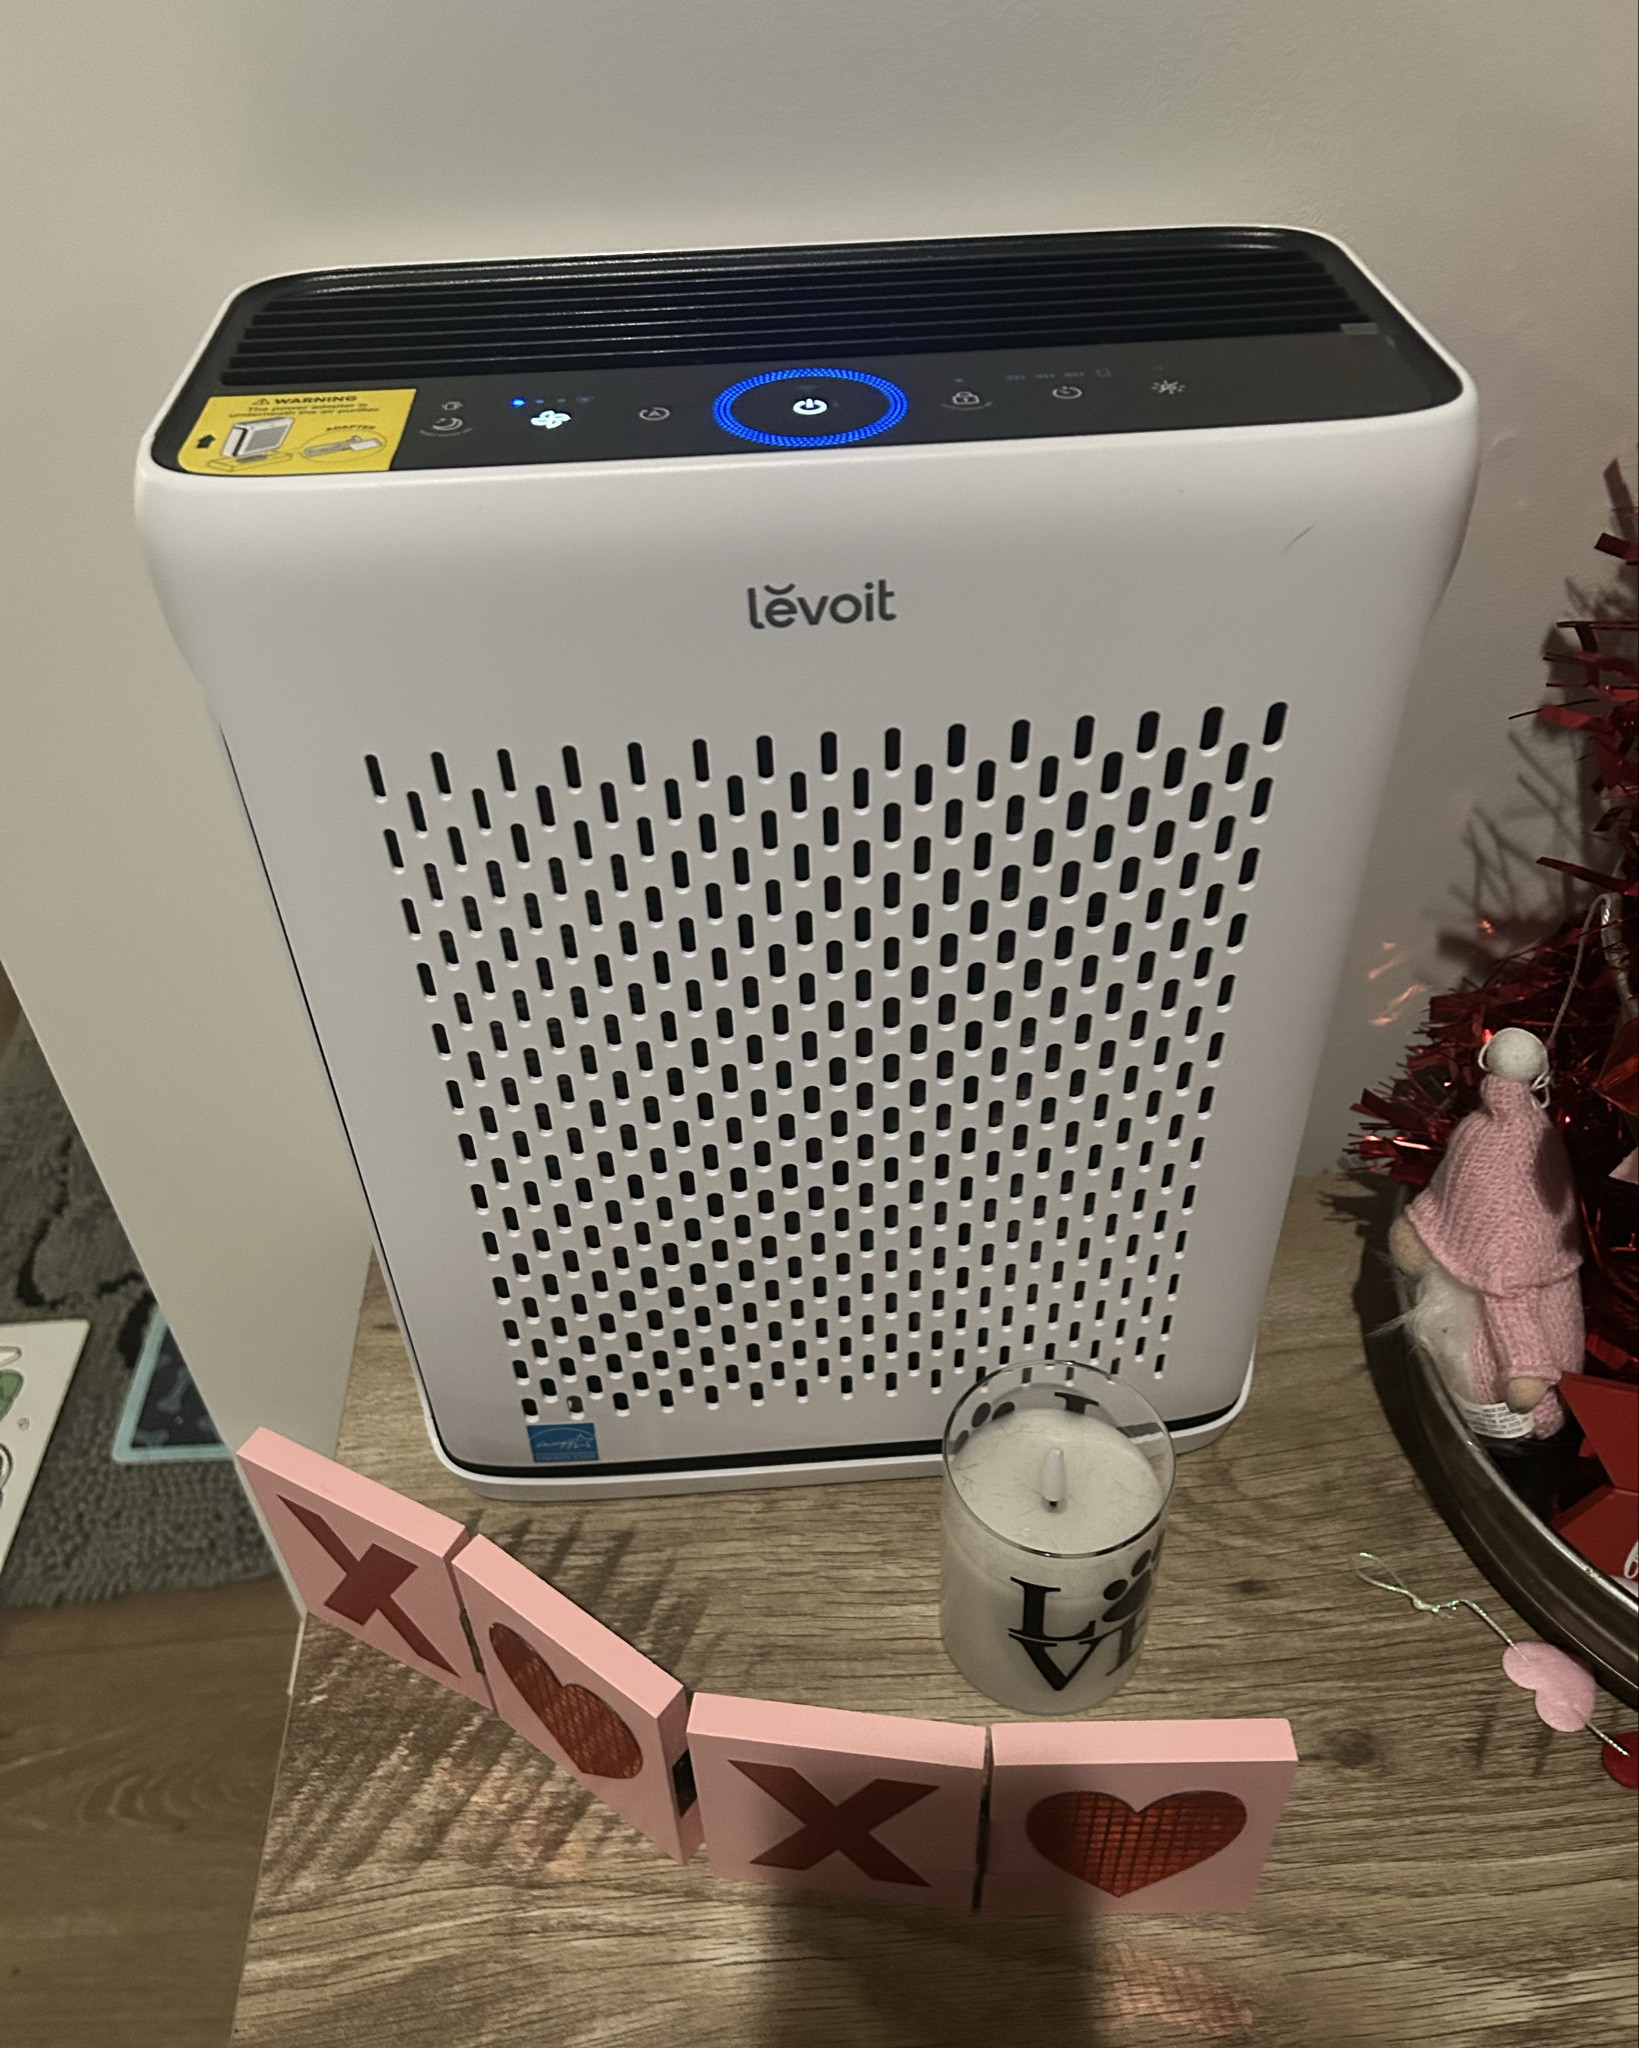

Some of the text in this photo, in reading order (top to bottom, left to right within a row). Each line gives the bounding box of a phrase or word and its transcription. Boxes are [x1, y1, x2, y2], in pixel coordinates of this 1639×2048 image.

[229, 410, 296, 418] underneath
[275, 396, 357, 404] WARNING
[277, 1494, 462, 1679] X
[726, 1759, 942, 1888] X
